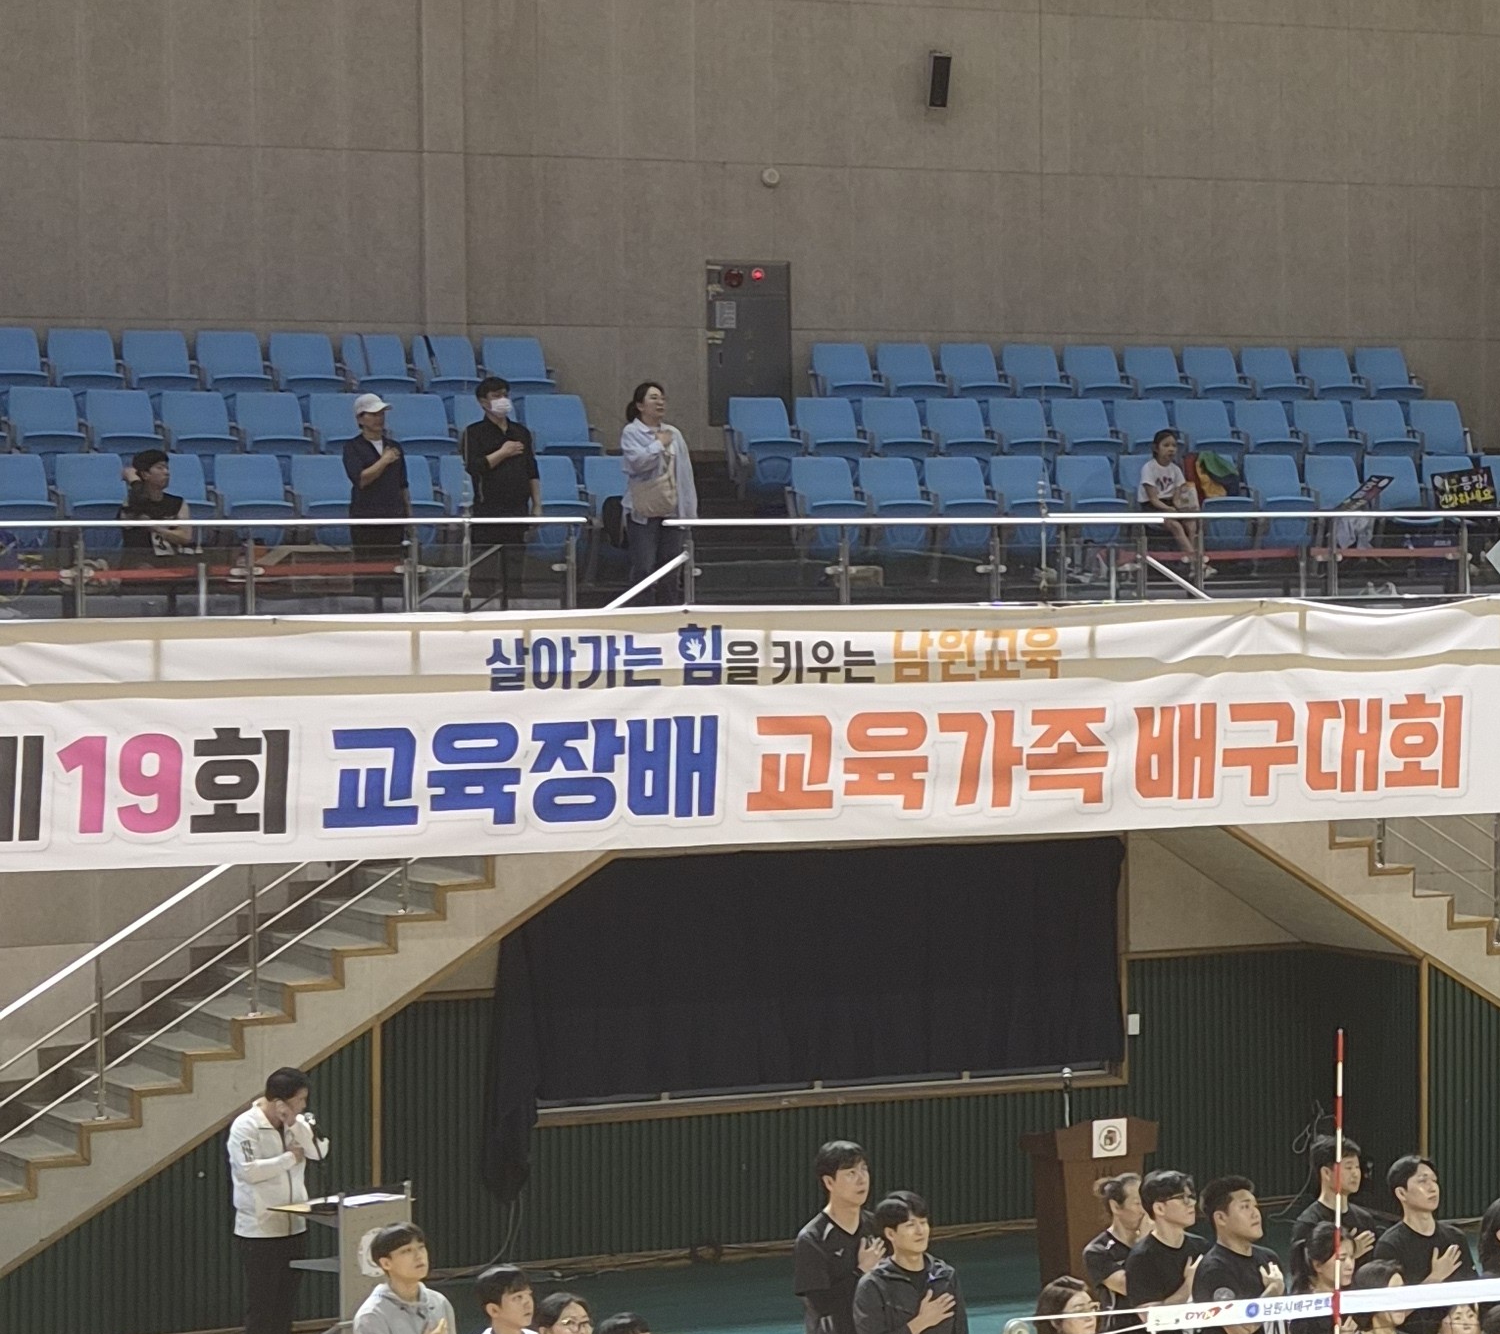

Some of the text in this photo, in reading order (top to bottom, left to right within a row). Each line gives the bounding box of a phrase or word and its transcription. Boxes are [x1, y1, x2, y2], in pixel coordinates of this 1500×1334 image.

[485, 623, 1062, 692] 살아가는 힘을 키우는 남원교육
[323, 715, 720, 830] 교육장배
[746, 707, 1109, 813] 교육가족
[1133, 693, 1464, 800] 배구대회
